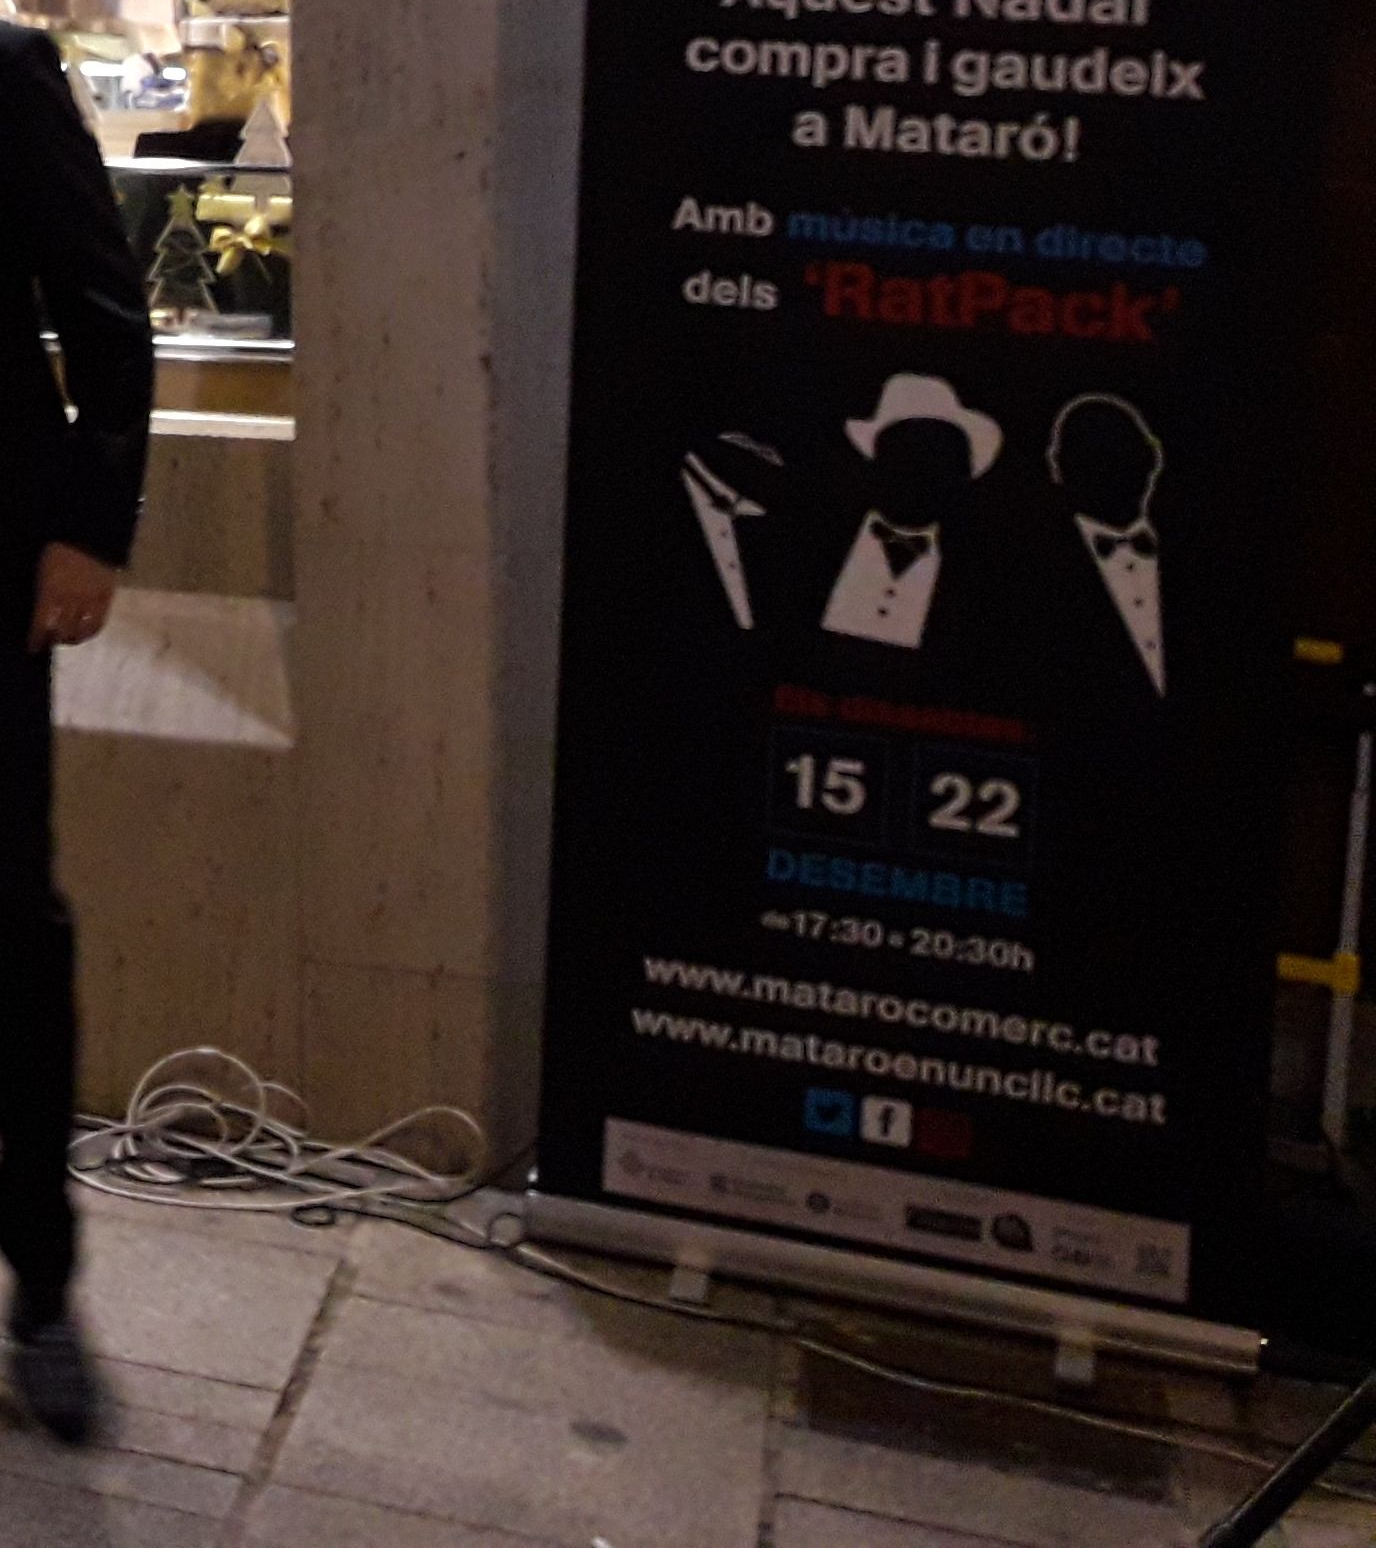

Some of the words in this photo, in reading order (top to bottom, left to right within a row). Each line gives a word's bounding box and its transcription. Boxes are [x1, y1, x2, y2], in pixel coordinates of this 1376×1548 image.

[686, 37, 910, 88] compra
[924, 39, 940, 85] i
[951, 48, 1204, 100] gaudeix
[792, 110, 828, 147] a
[844, 104, 1080, 161] Mataró!
[672, 196, 774, 237] Amb
[786, 209, 955, 252] música
[965, 223, 1025, 254] en
[1033, 223, 1208, 268] directe
[682, 270, 778, 311] dels
[786, 754, 867, 815] 15
[928, 772, 1021, 838] 22
[765, 850, 1029, 917] DESEMBRE
[643, 955, 1160, 1068] www.matarocomerc.cat
